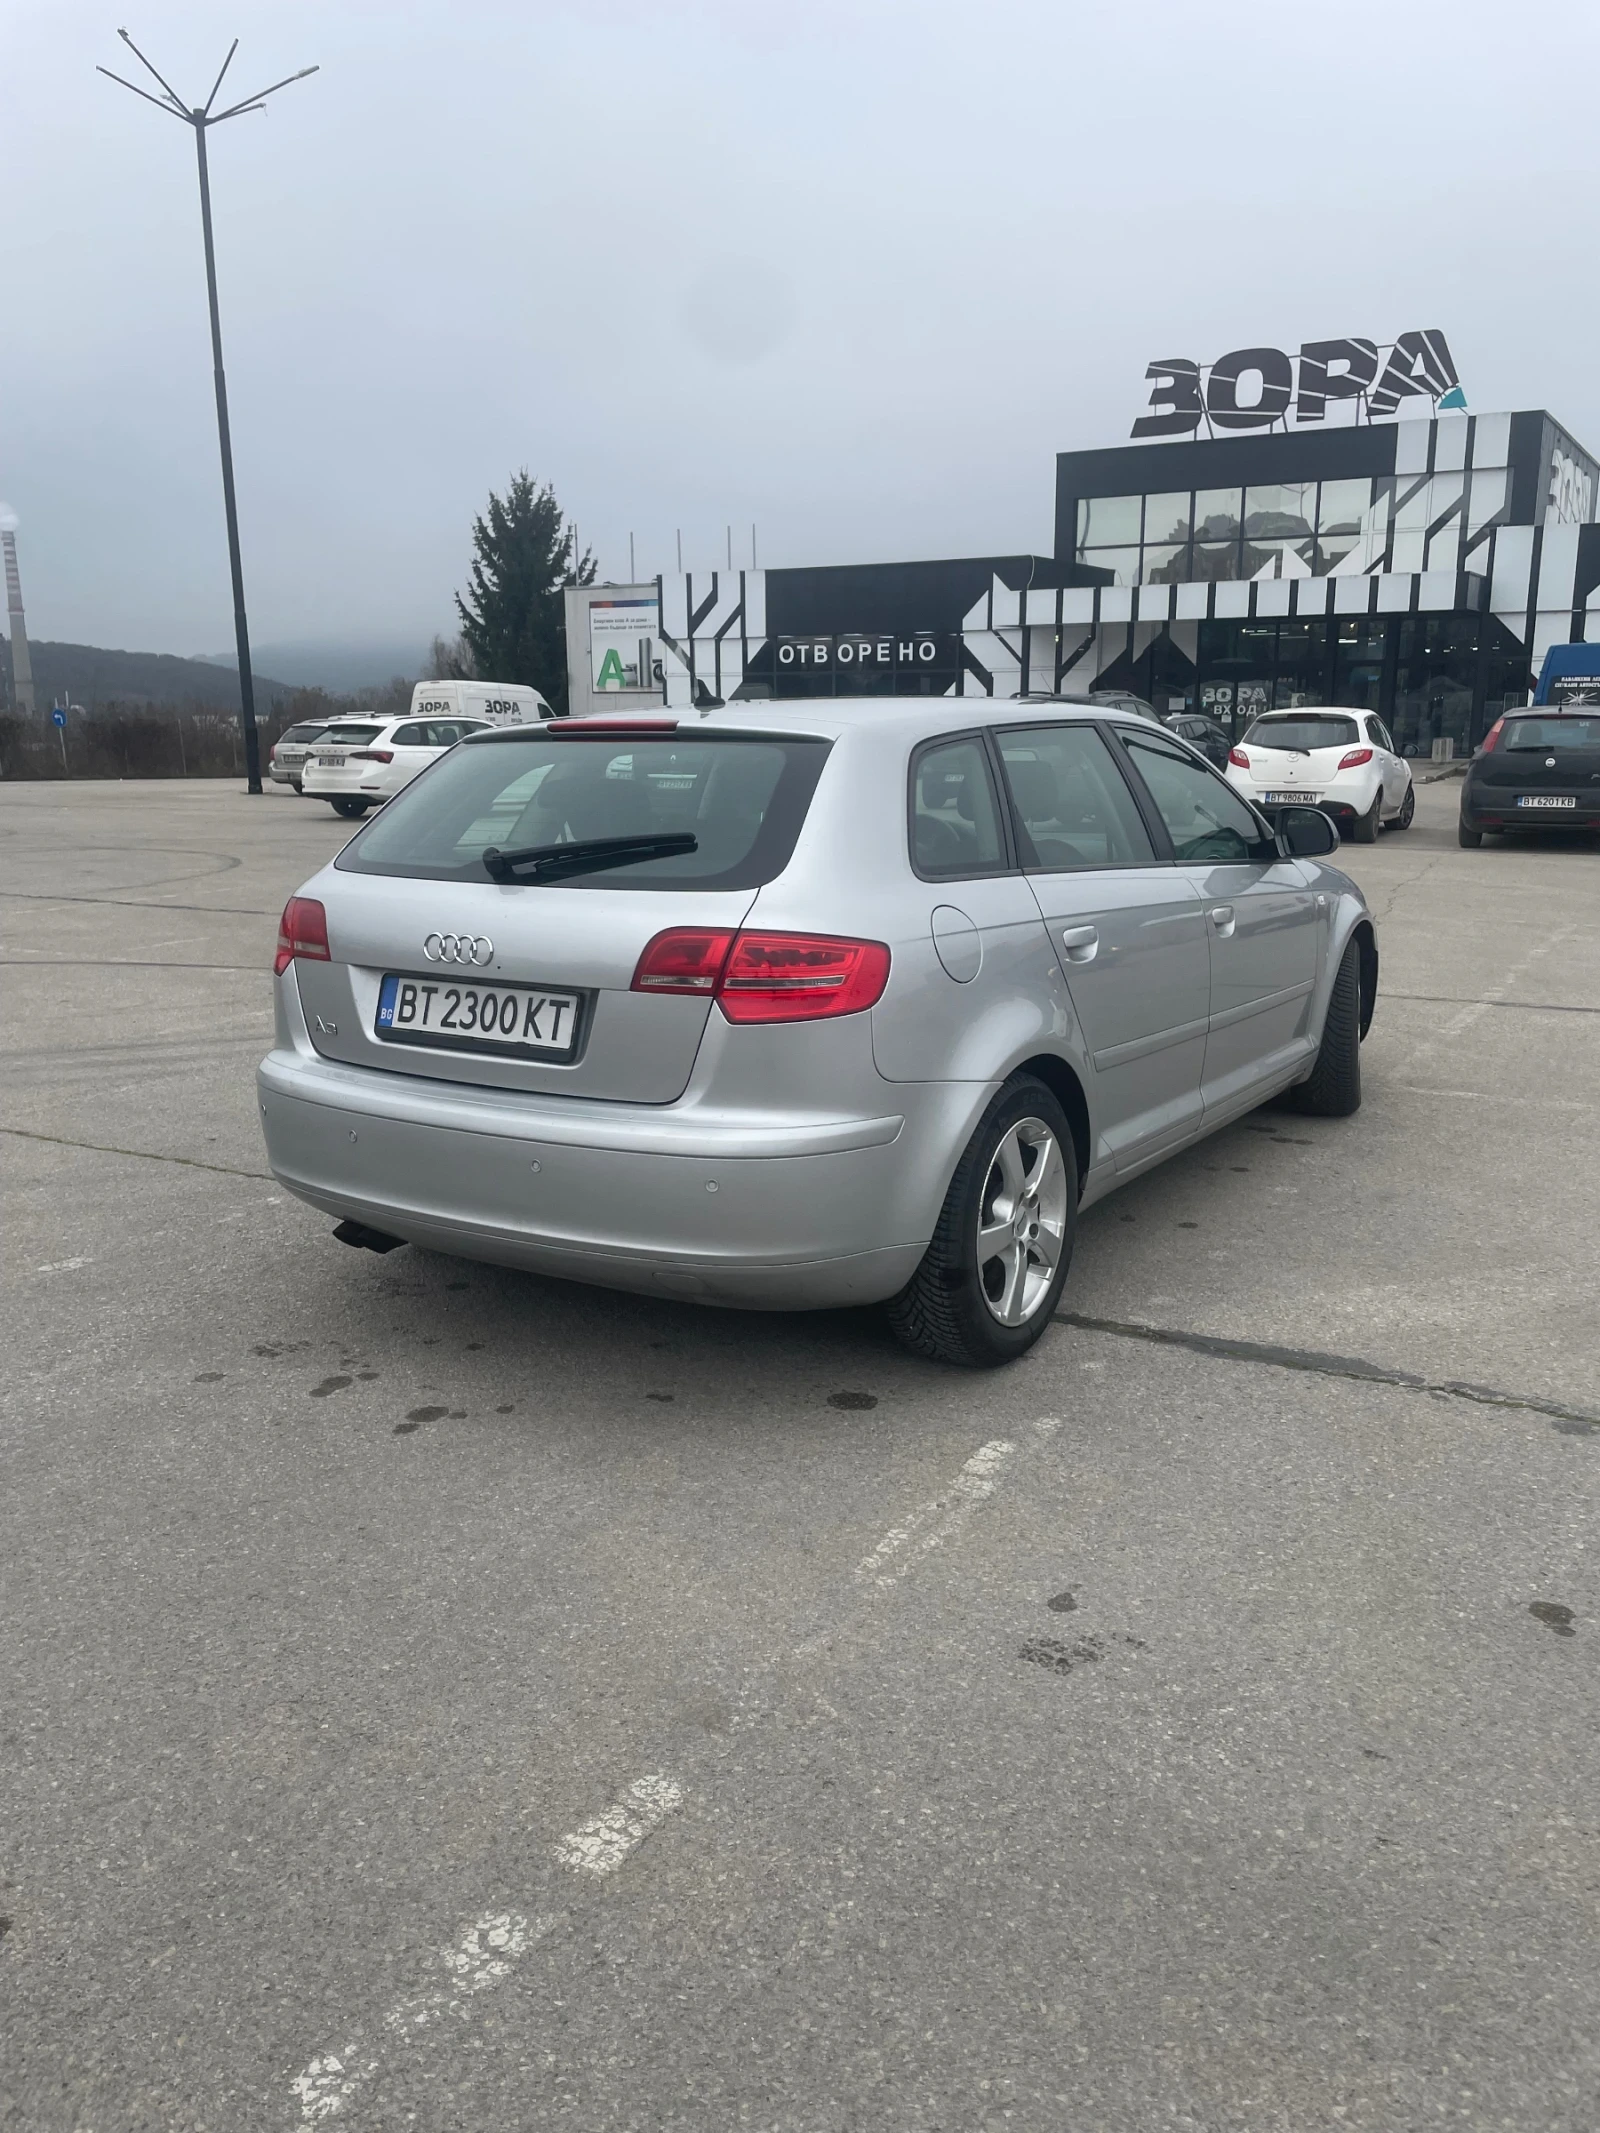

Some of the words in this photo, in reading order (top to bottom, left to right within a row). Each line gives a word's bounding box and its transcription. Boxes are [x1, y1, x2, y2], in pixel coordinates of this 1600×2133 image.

[1130, 329, 1467, 438] ЗОРА
[417, 701, 451, 713] ЗОРА
[484, 700, 522, 715] ЗОРА
[380, 1008, 393, 1020] BG
